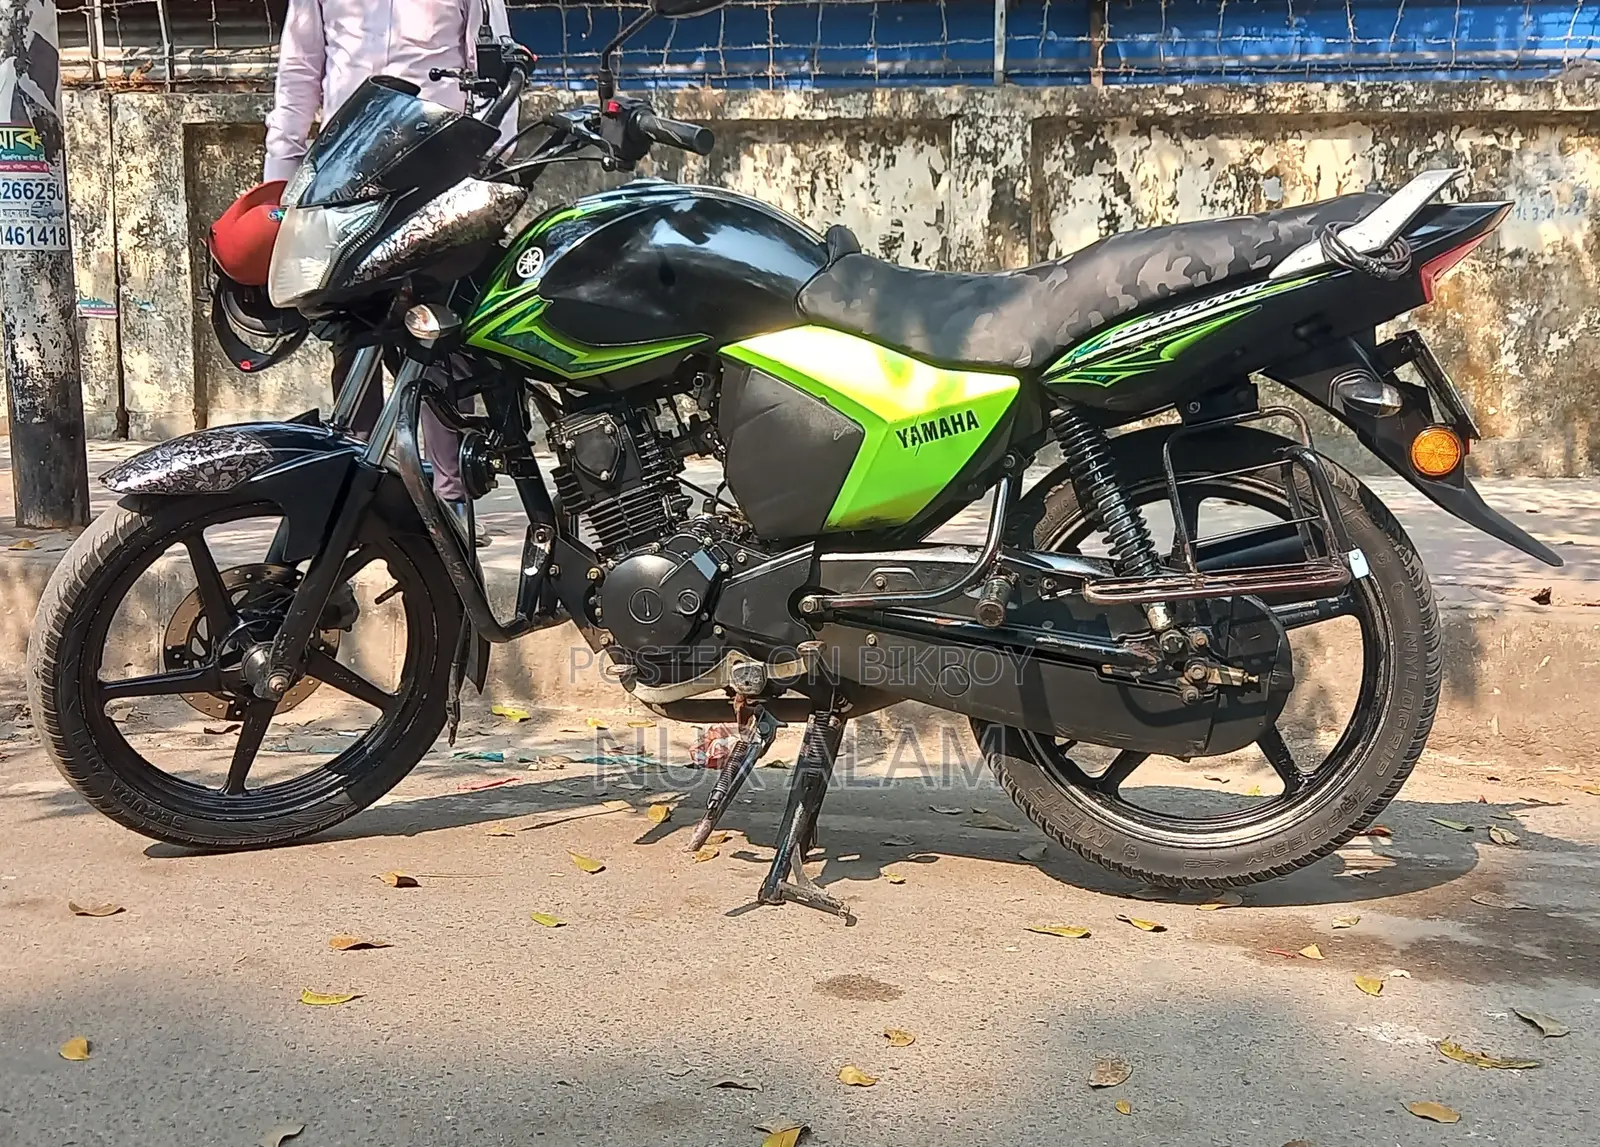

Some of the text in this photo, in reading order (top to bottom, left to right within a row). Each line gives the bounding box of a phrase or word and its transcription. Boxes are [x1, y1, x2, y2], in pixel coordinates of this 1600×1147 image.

[0, 182, 63, 201] 266250
[895, 409, 980, 449] YAMAHA
[1029, 786, 1113, 849] MRF
